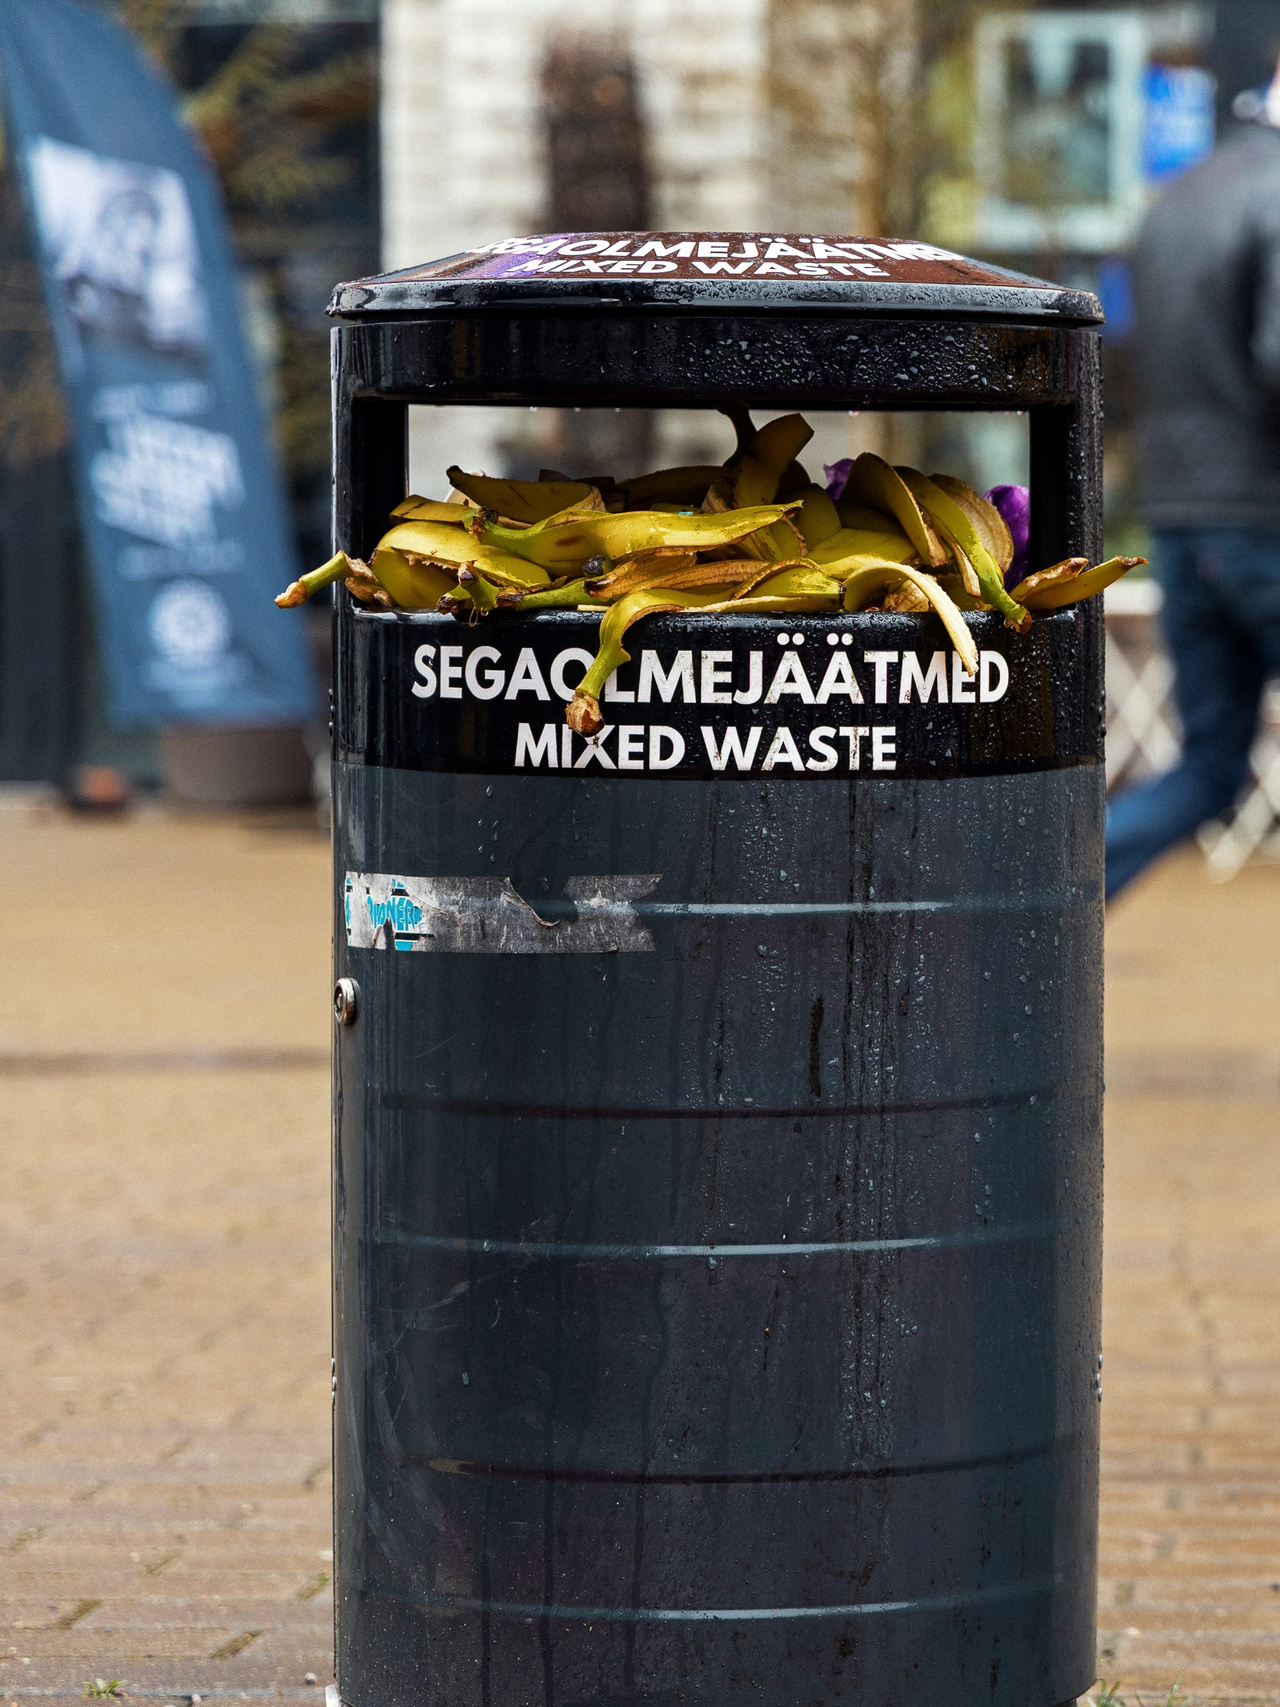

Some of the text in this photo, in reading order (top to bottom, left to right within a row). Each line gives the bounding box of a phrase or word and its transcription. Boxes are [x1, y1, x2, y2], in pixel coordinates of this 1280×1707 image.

[506, 259, 891, 276] MIXED WASTE
[514, 722, 897, 771] MIXED WASTE
